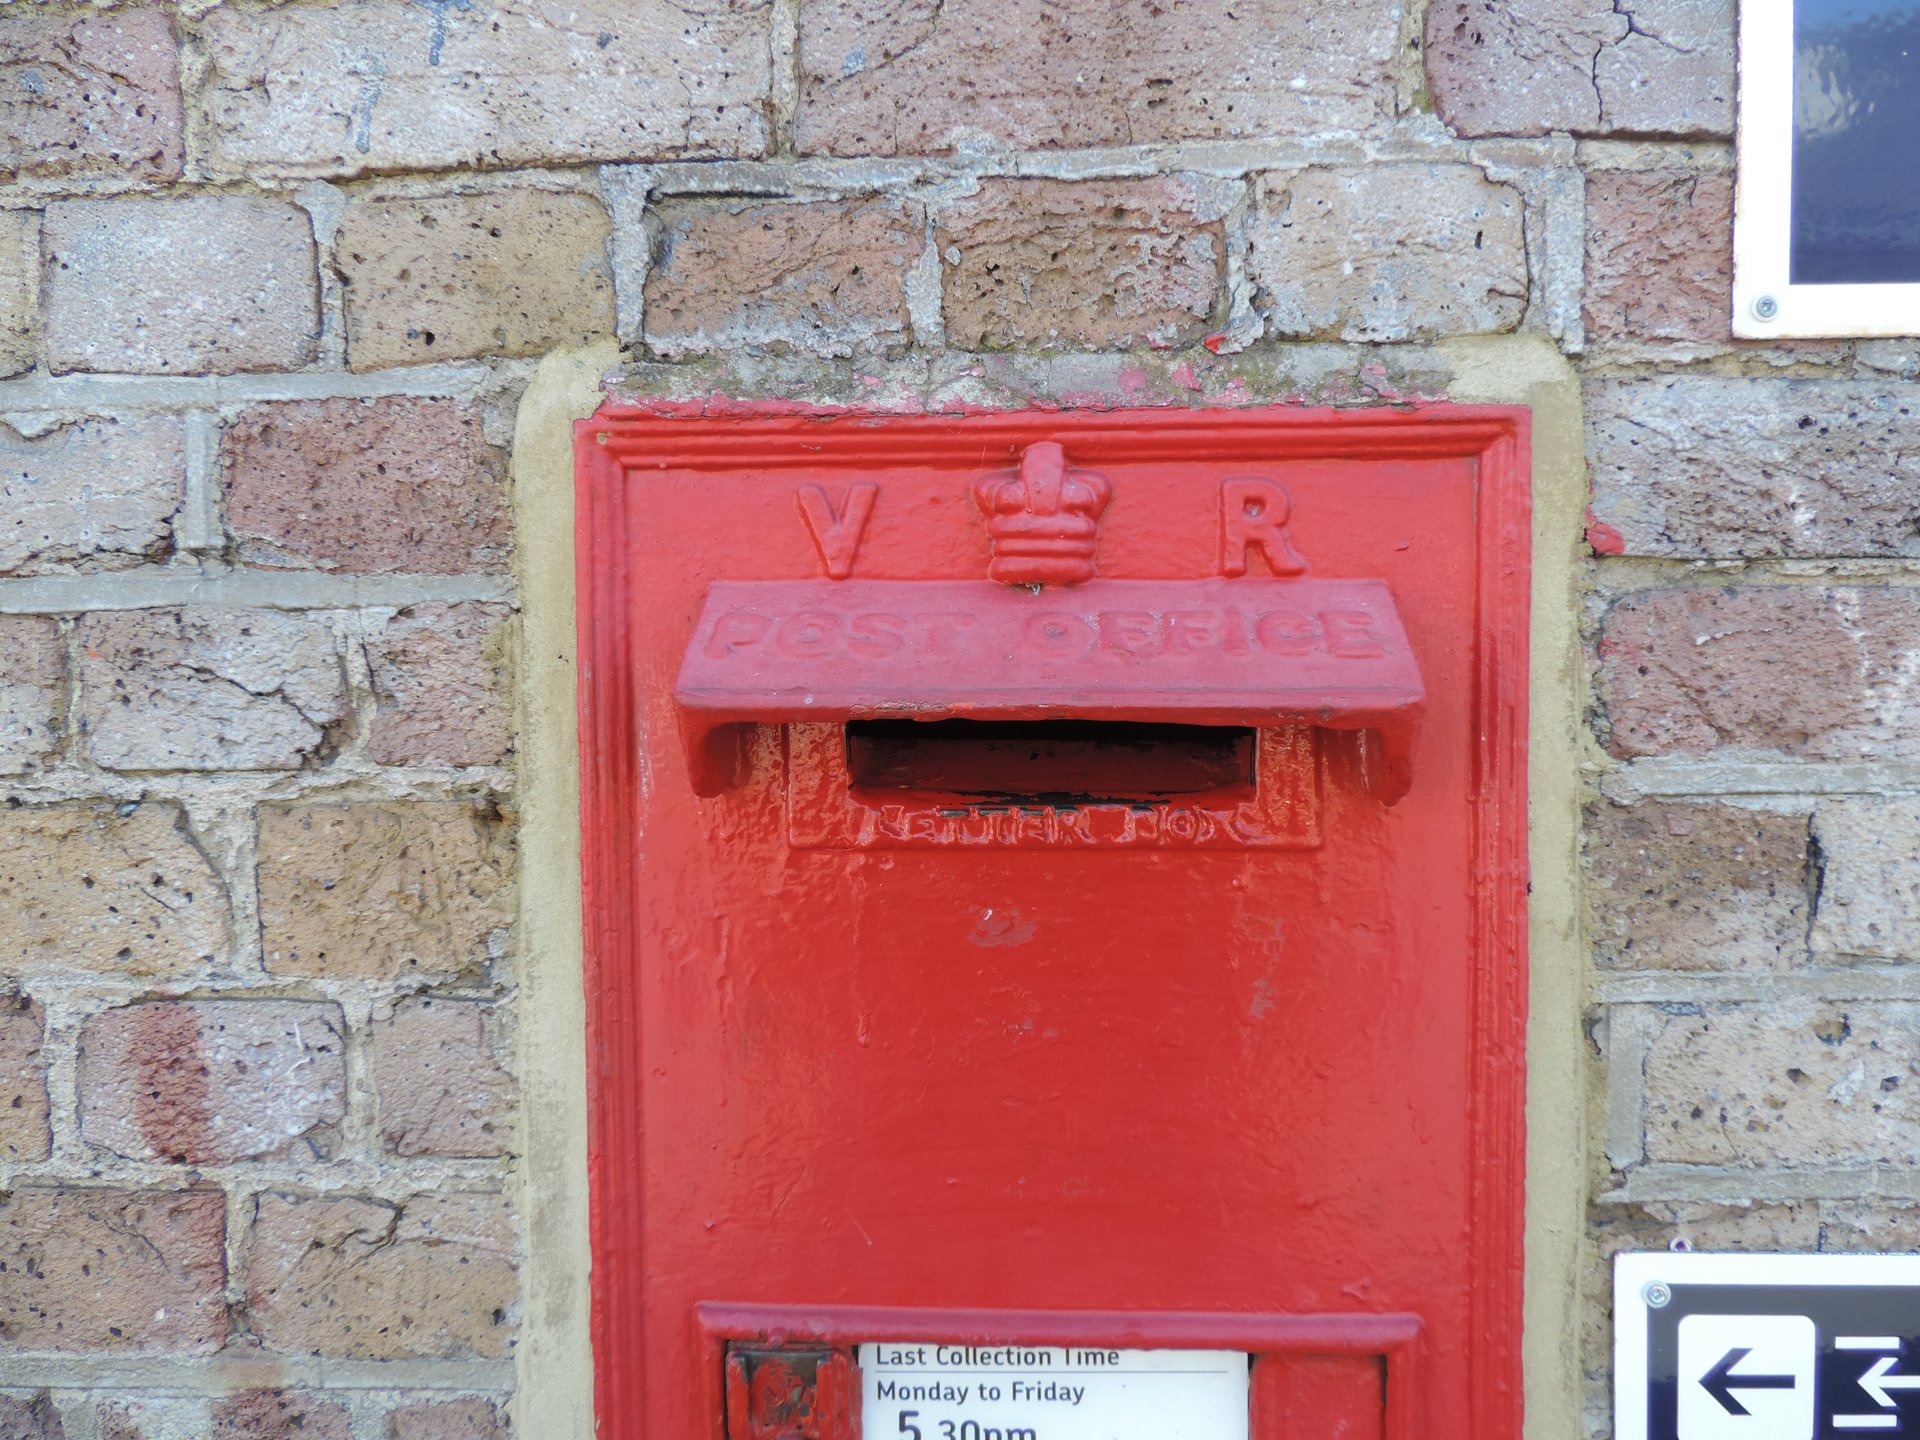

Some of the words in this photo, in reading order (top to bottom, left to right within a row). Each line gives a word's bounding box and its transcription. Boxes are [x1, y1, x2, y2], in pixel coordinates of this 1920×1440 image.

[795, 480, 880, 582] V
[1217, 475, 1306, 579] R
[703, 612, 977, 659] POST
[1023, 606, 1385, 660] OFFICE
[876, 1345, 927, 1366] Last
[935, 1346, 1052, 1366] Collection
[876, 1380, 970, 1406] Monday
[978, 1383, 1001, 1401] to
[1011, 1380, 1086, 1406] Friday
[898, 1410, 1037, 1440] 530m
